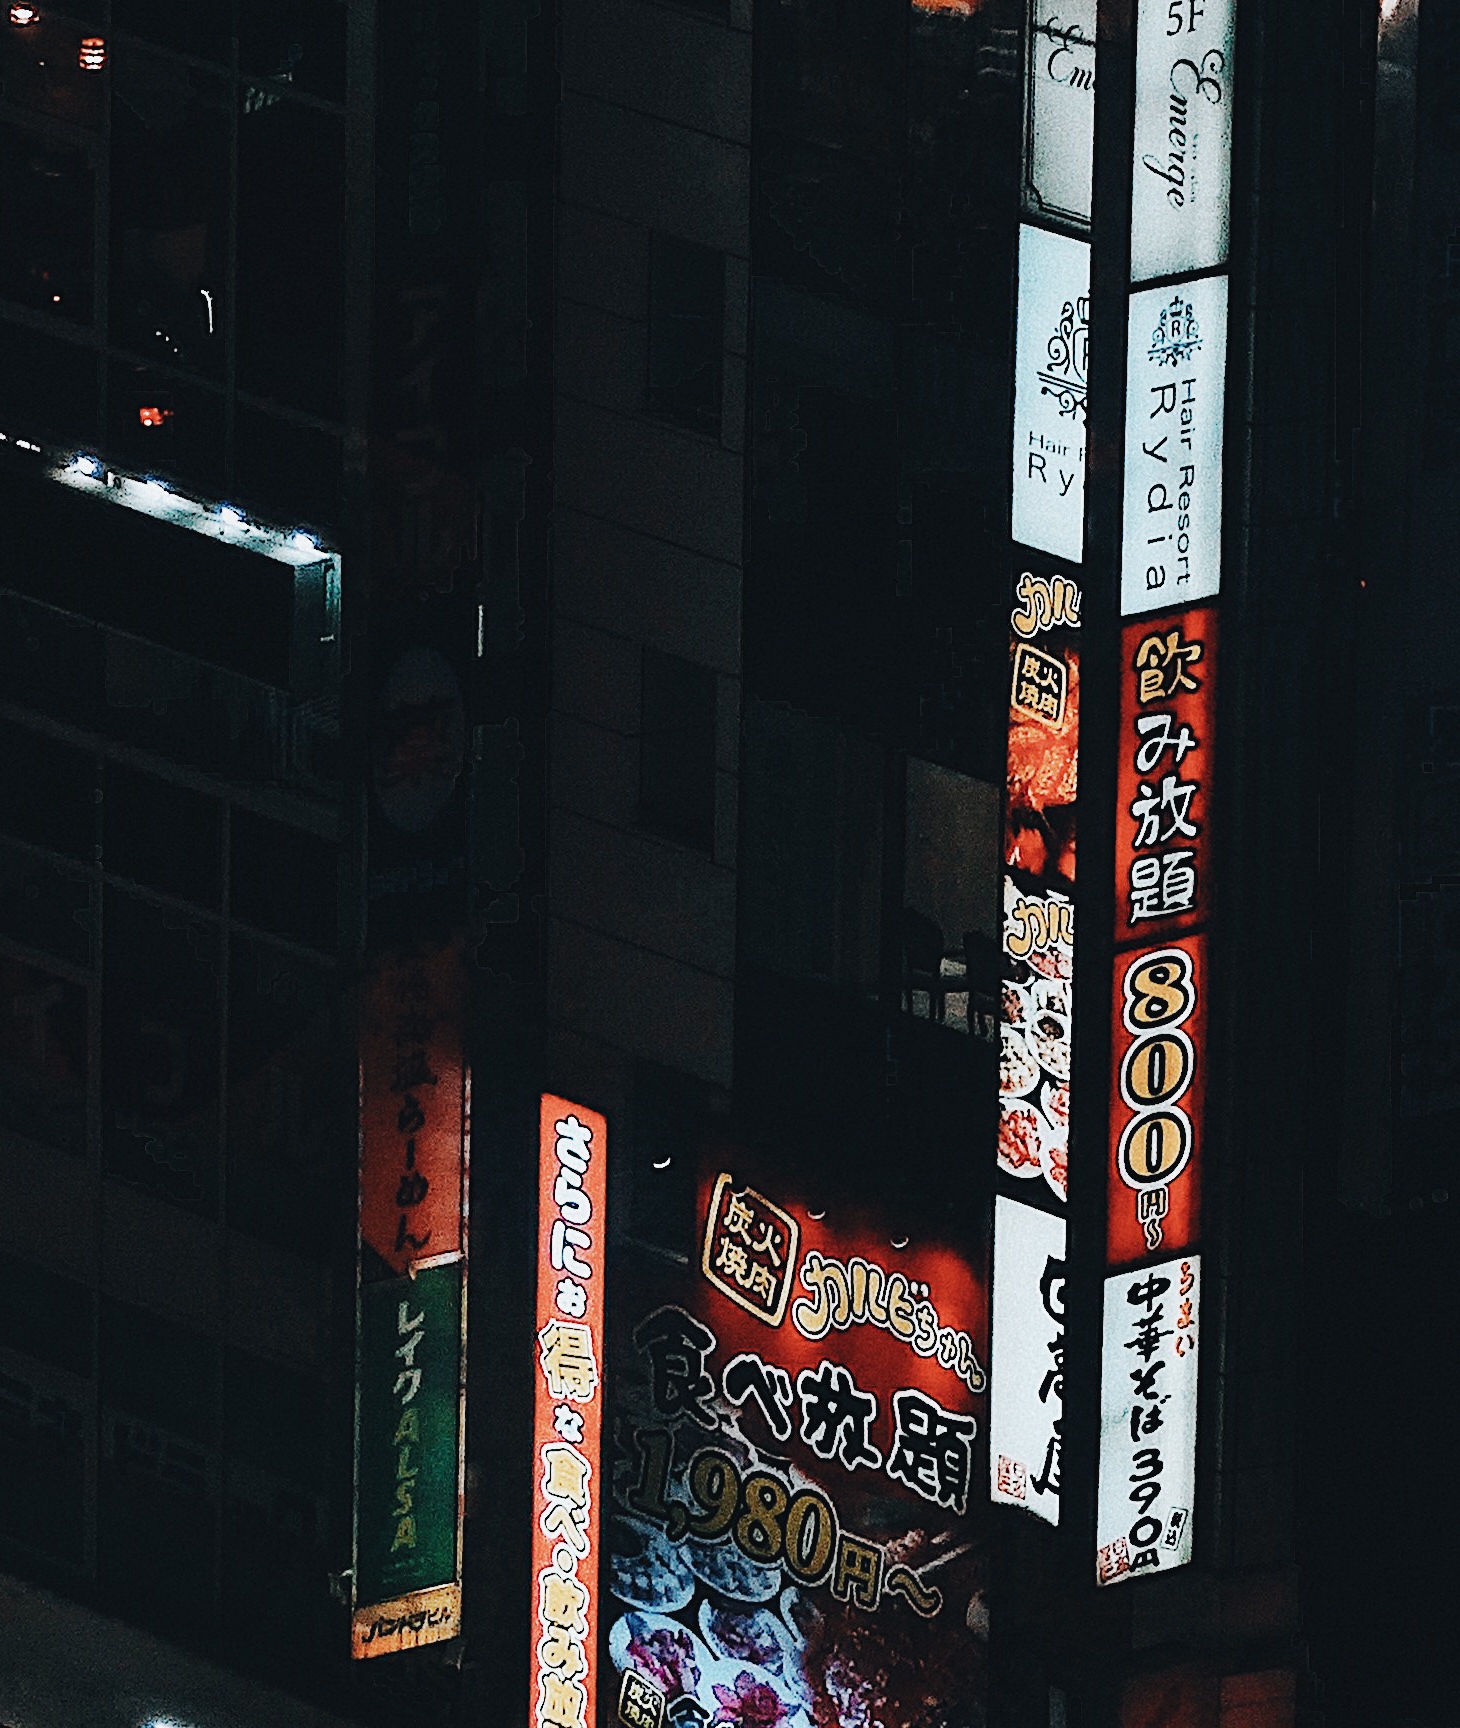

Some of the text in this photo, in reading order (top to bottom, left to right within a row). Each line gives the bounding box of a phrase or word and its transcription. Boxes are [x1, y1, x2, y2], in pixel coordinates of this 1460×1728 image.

[1047, 48, 1096, 92] Em
[1142, 58, 1200, 213] Emerge
[1028, 451, 1075, 497] Ry
[1029, 430, 1071, 458] Hair
[1142, 380, 1177, 592] Rydia
[1175, 378, 1197, 586] Hair Resort
[1128, 630, 1204, 925] 飲み放題
[714, 1235, 779, 1307] 焼肉
[723, 1198, 783, 1267] 炭火
[792, 1251, 987, 1393] カルビちゃん
[1176, 1261, 1196, 1358] うまい
[634, 1304, 978, 1516] 食べ放題
